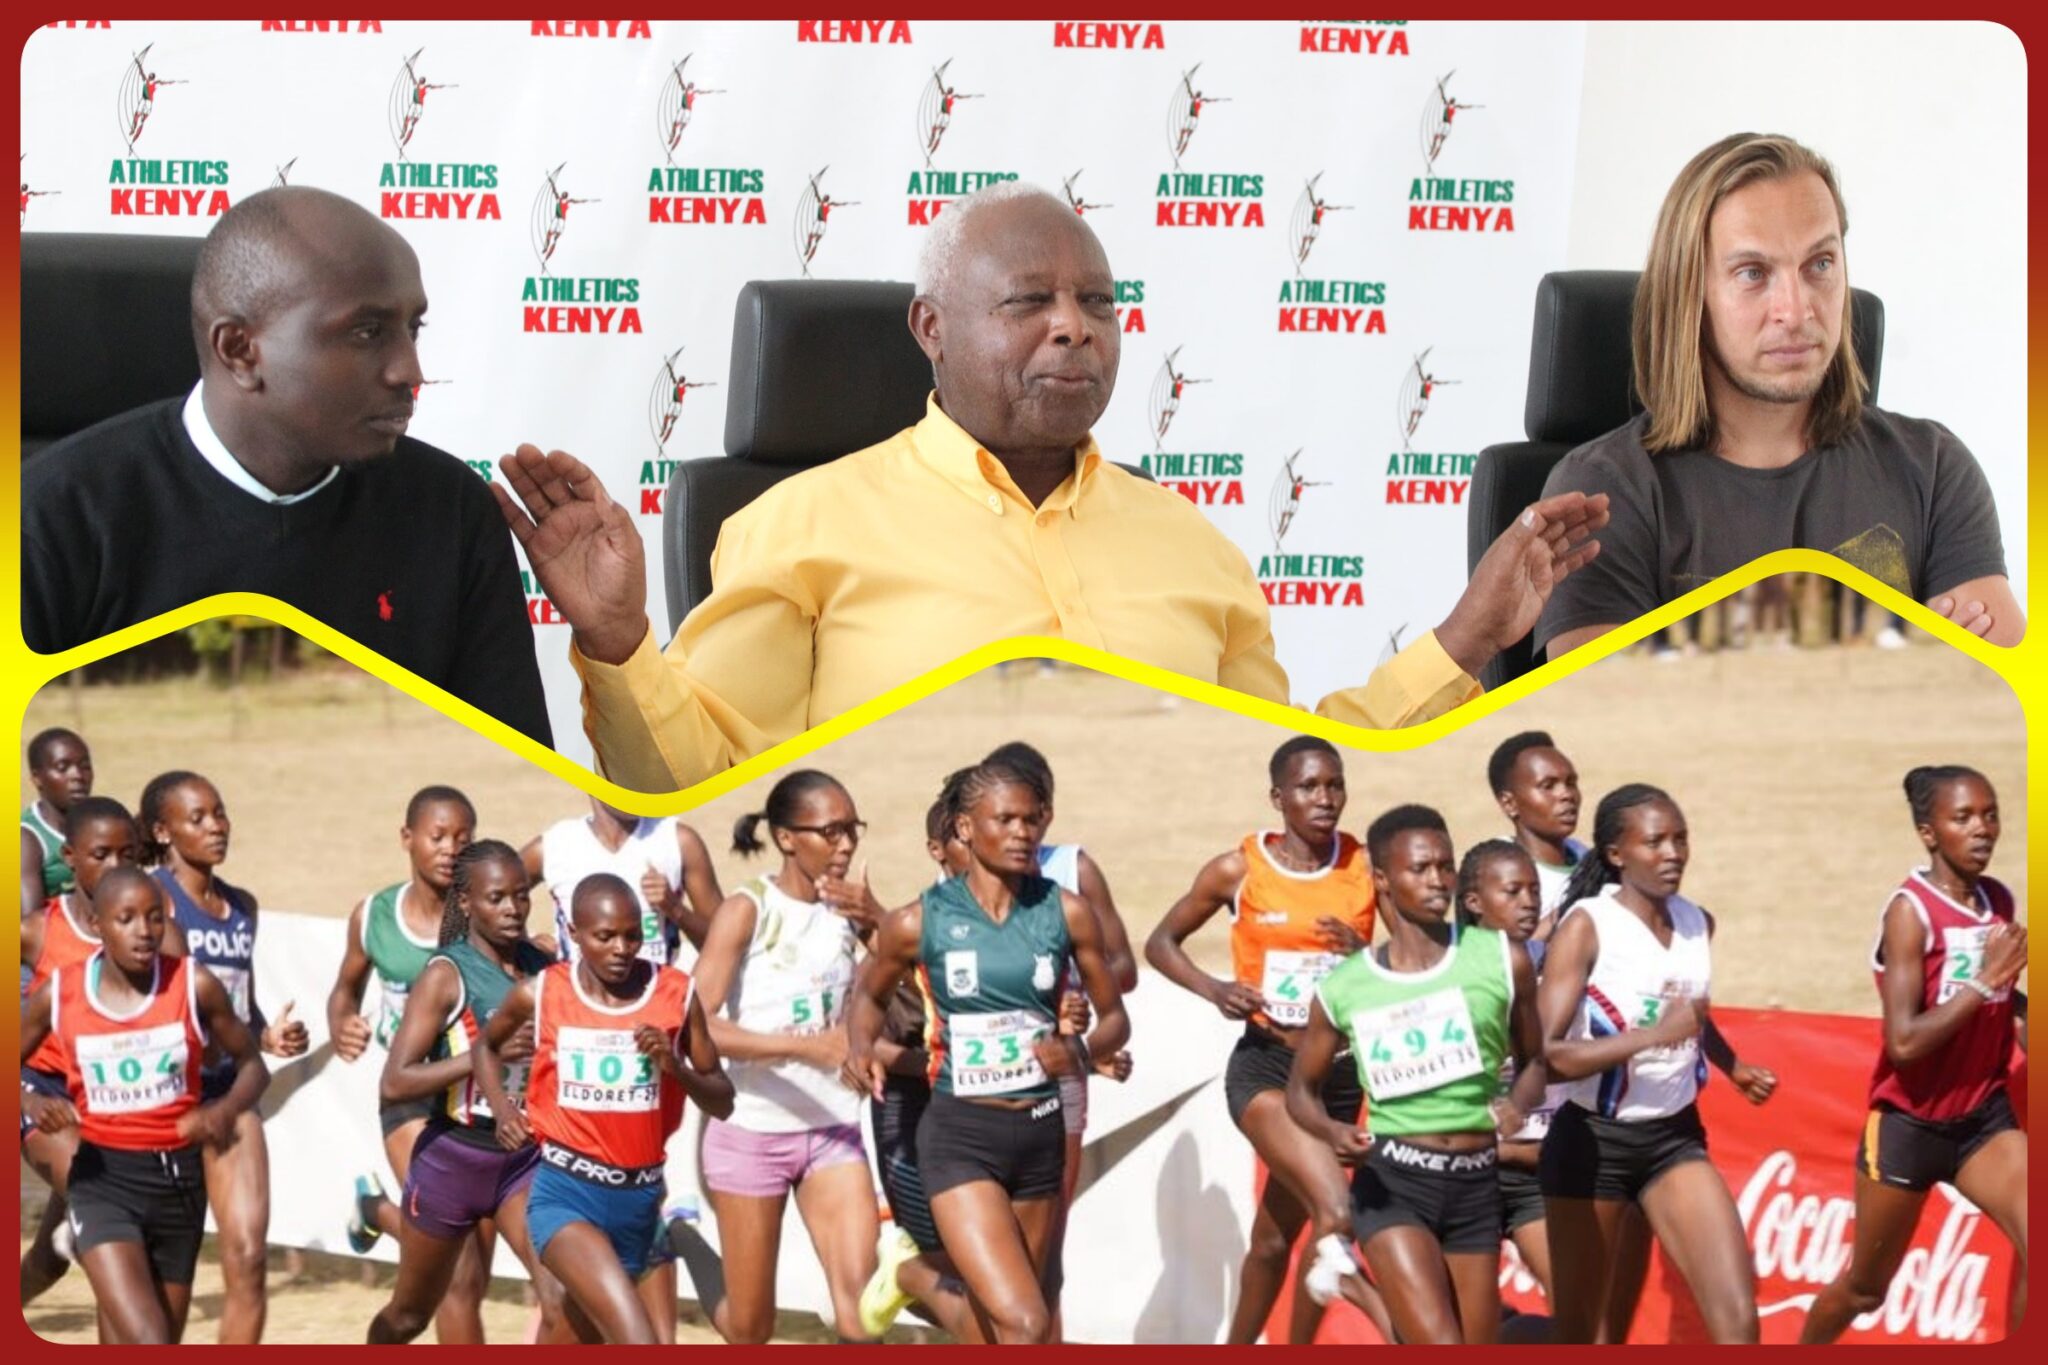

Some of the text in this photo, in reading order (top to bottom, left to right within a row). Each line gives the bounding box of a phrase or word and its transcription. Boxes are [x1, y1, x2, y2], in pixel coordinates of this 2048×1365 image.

[798, 20, 912, 43] KENYA
[1055, 22, 1165, 48] KENYA
[1300, 28, 1409, 55] KENYA
[109, 160, 229, 185] ATHLETICS
[379, 163, 498, 188] ATHLETICS
[648, 168, 764, 193] ATHLETICS
[1157, 173, 1264, 197] ATHLETICS
[111, 189, 231, 216] KENYA
[1409, 178, 1513, 203] ATHLETICS
[381, 192, 501, 220] KENYA
[649, 197, 767, 224] KENYA
[1156, 202, 1265, 227] KENYA
[1408, 206, 1514, 231] KENYA
[522, 278, 640, 302] ATHLETICS
[1279, 280, 1386, 305] ATHLETICS
[524, 307, 642, 333] KENYA
[1279, 308, 1387, 333] KENYA
[1141, 453, 1243, 477] ATHLETICS
[1386, 480, 1468, 504] KENY
[1258, 555, 1364, 578] ATHLETICS
[1260, 582, 1364, 606] KENYA
[1369, 1017, 1466, 1062] 494
[90, 1051, 179, 1085] 104
[571, 1053, 653, 1085] 103
[1382, 1139, 1496, 1172] NIKE PRO
[570, 1158, 627, 1185] PRO
